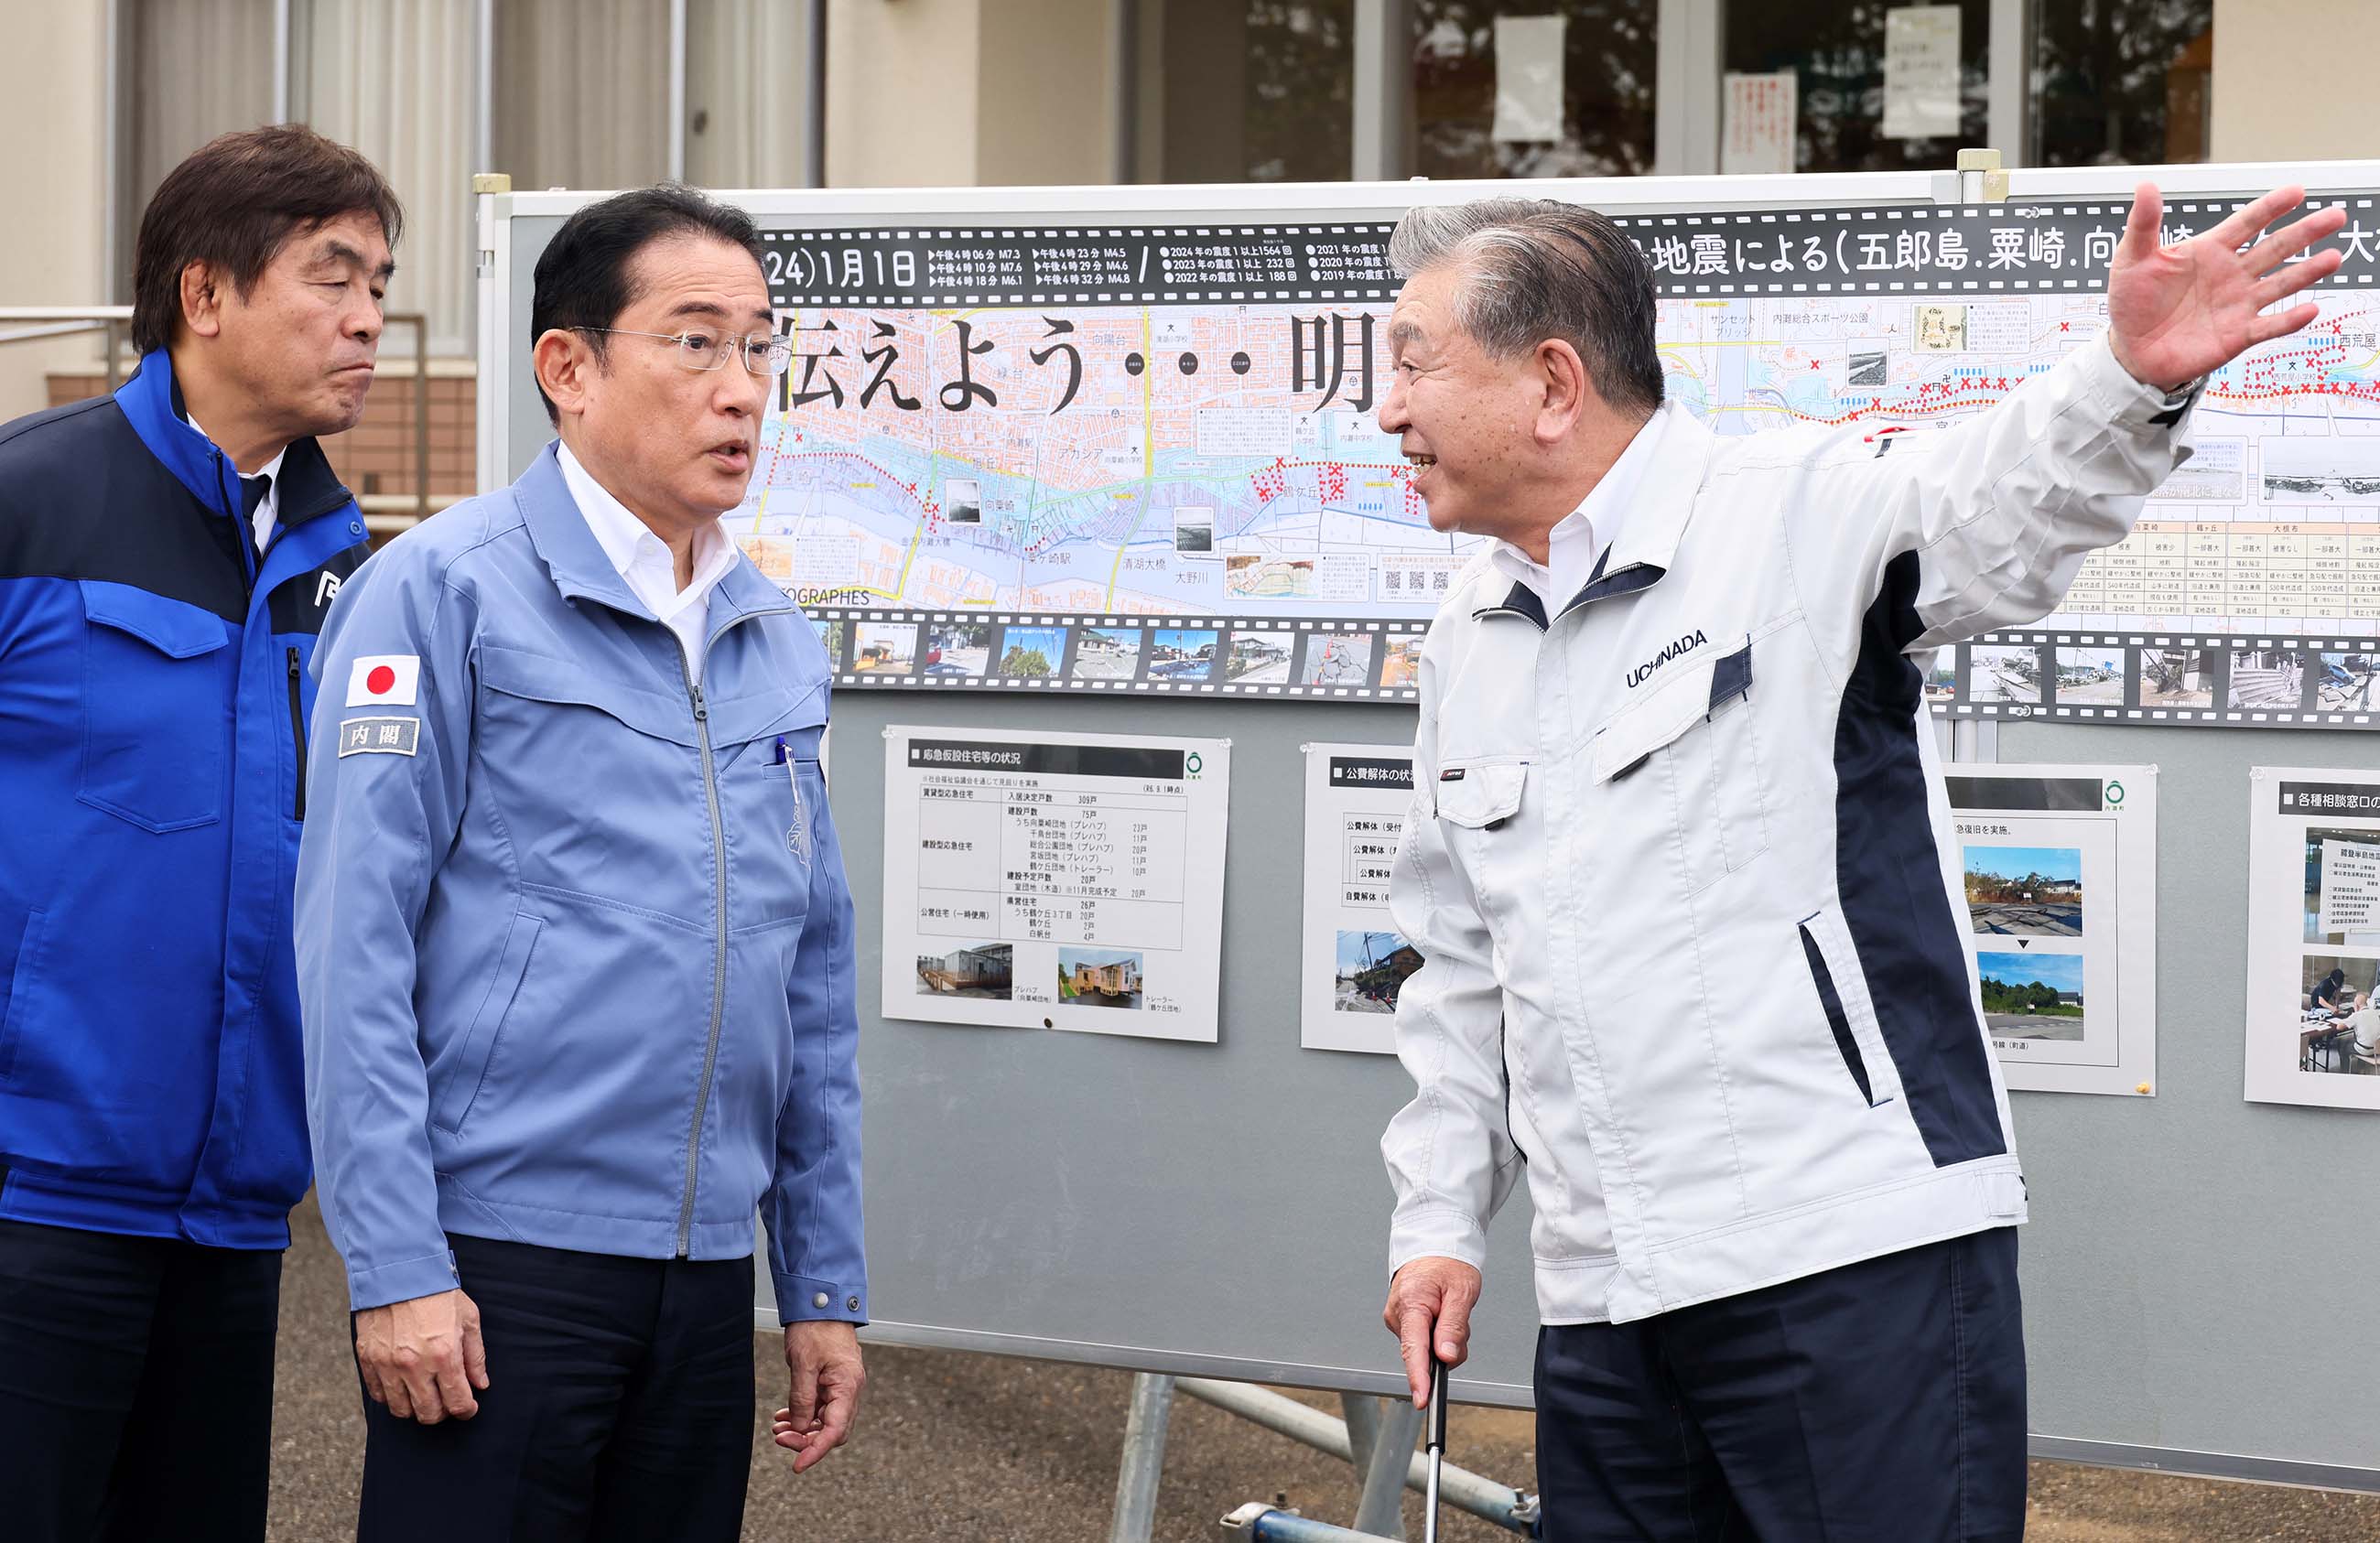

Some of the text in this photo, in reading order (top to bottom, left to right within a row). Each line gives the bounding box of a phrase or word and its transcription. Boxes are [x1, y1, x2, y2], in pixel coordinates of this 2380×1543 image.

[999, 250, 1022, 259] M7.3
[1104, 249, 1126, 258] M4.5
[1001, 263, 1022, 272] M7.6
[1106, 262, 1129, 271] M4.6
[1001, 275, 1022, 285] M6.1
[1108, 275, 1130, 284] M4.8
[1711, 315, 1756, 324] サンセット
[1773, 313, 1869, 324] 内灘総合スポーツ公園
[1716, 328, 1751, 337] ブリッジ
[2340, 333, 2376, 347] 西荒屋
[2274, 373, 2317, 382] 西荒屋小学校
[1059, 448, 1104, 459] アカシア
[1175, 571, 1209, 584] 大野川
[780, 587, 871, 606] OGRAPHES
[1626, 629, 1708, 688] UCHINADA
[350, 723, 402, 748] 内閣
[923, 749, 1021, 765] 応急仮設住宅等の状況
[1008, 806, 1038, 816] 建設戸数
[923, 839, 973, 851] 建設型応急住宅
[1007, 871, 1052, 882] 建設予定戸数
